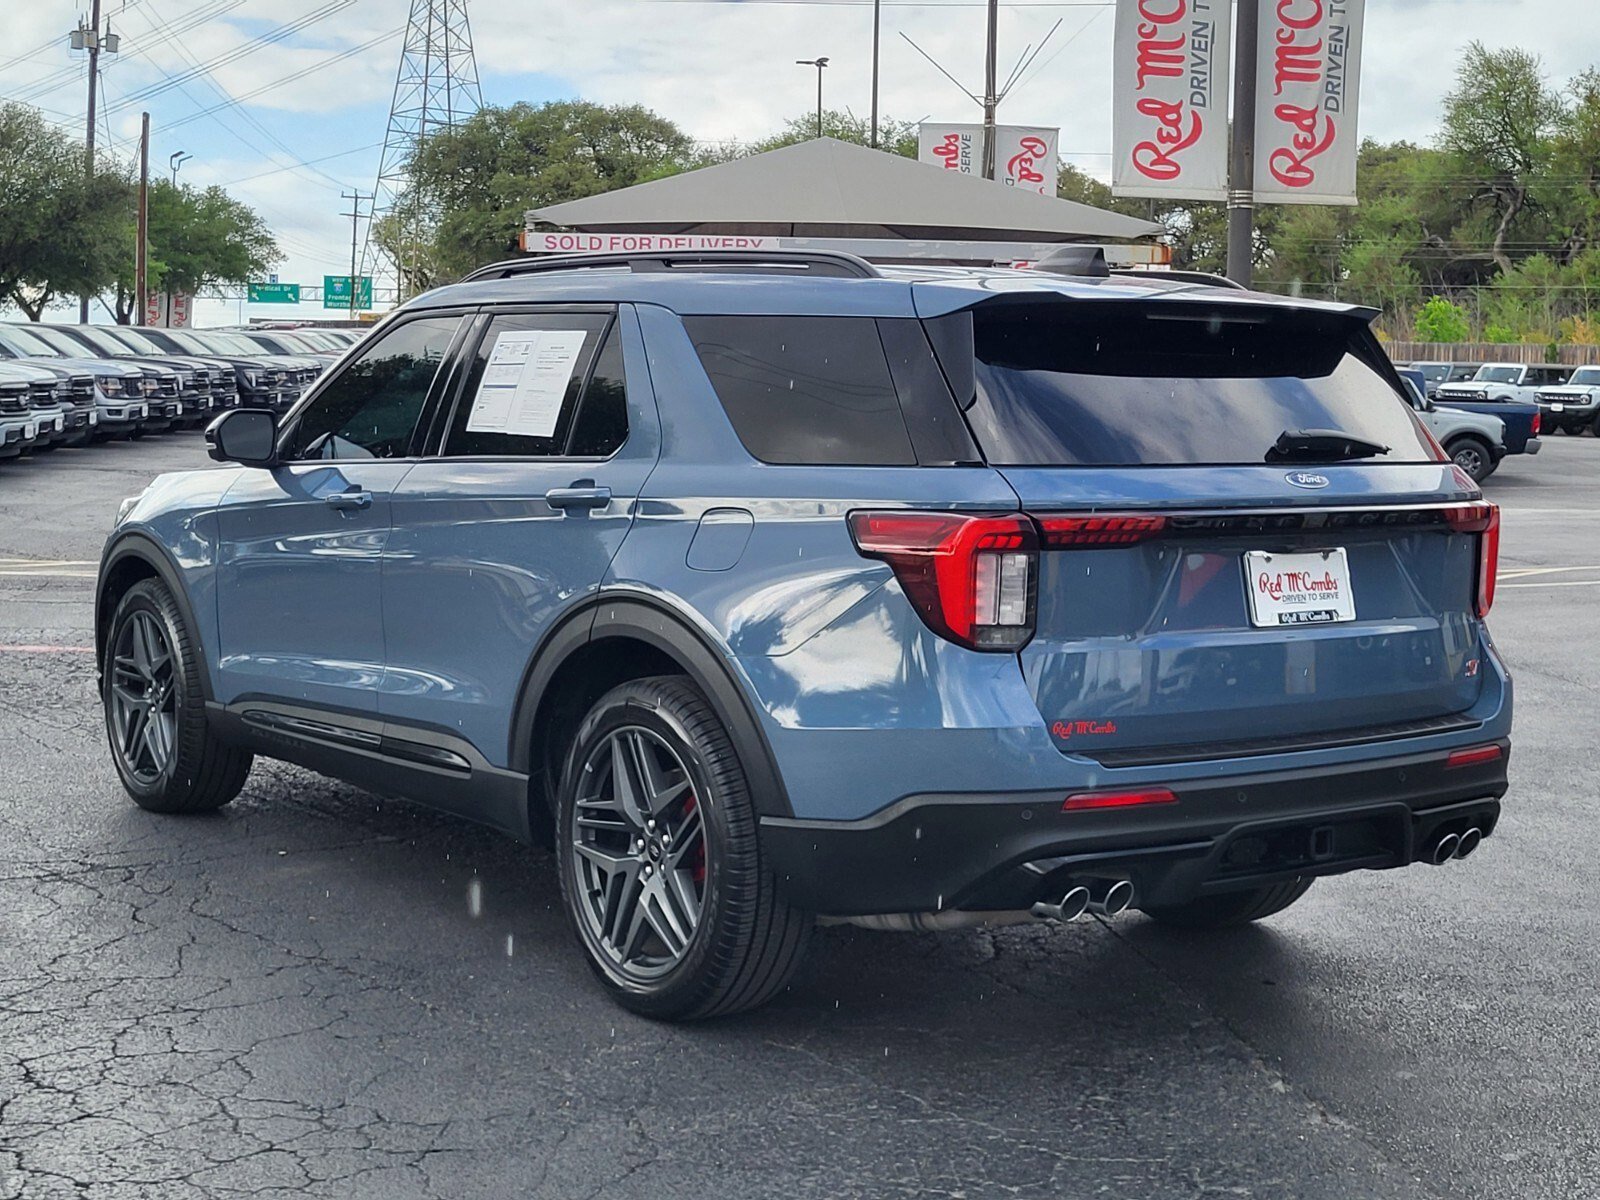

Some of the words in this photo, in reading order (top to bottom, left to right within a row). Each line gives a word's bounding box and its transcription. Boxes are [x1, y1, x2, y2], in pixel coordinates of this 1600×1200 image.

[1190, 21, 1210, 108] DRIVEN
[1324, 26, 1345, 113] DRIVEN
[961, 134, 971, 173] SERVE
[1132, 98, 1203, 180] Red
[1269, 104, 1336, 187] Red
[1008, 137, 1047, 182] Red
[544, 235, 602, 251] SOLD
[609, 236, 652, 250] FOR
[659, 237, 764, 249] DELIVERY
[1297, 473, 1321, 484] Ford
[1259, 572, 1283, 601] Red
[1284, 571, 1338, 592] McCombs
[1282, 594, 1306, 602] DRIVEN
[1308, 593, 1317, 601] TO
[1318, 592, 1339, 600] SERVE
[1052, 721, 1073, 739] Red
